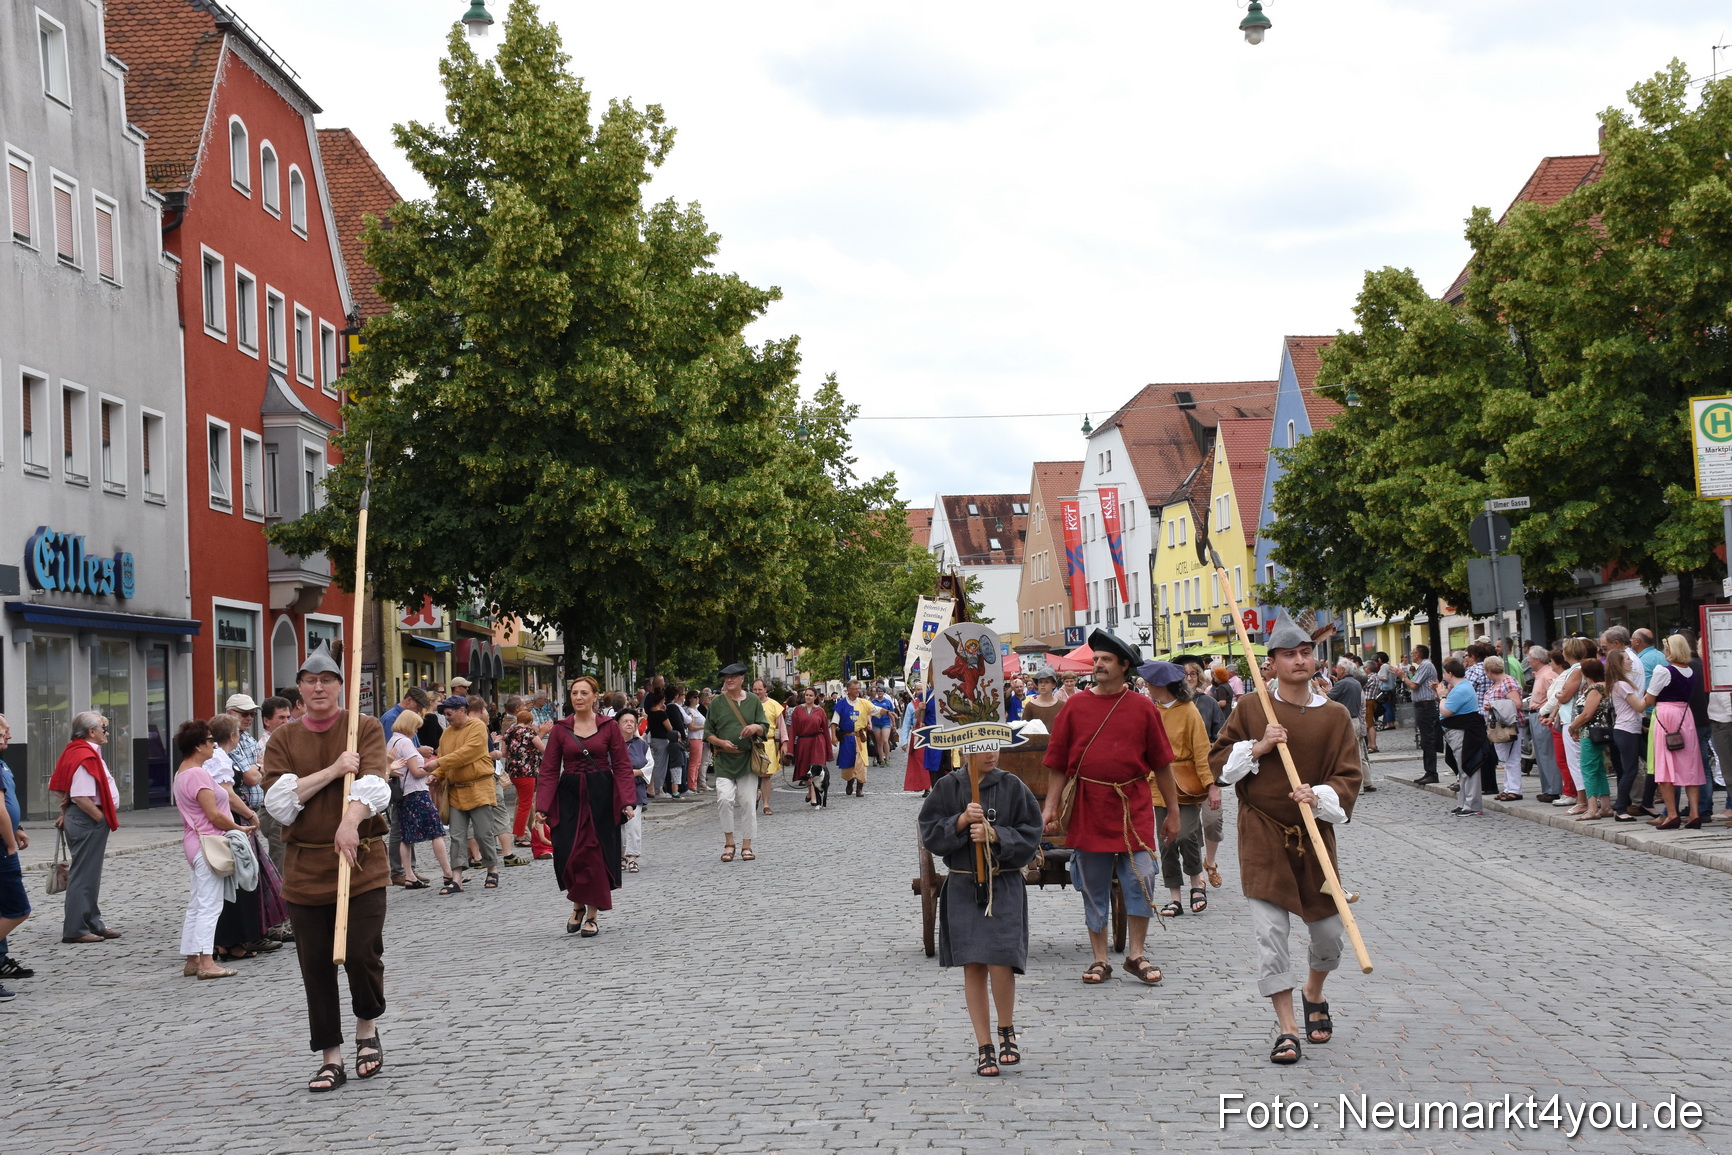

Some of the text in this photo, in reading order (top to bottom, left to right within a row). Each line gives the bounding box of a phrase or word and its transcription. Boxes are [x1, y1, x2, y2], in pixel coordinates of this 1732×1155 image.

[1101, 491, 1113, 519] K&L
[1510, 499, 1528, 507] Gasse
[27, 525, 115, 597] Eilles
[1175, 561, 1189, 576] HOTEL
[932, 727, 1011, 745] Michaeli-Verein
[964, 742, 999, 753] HEMAU
